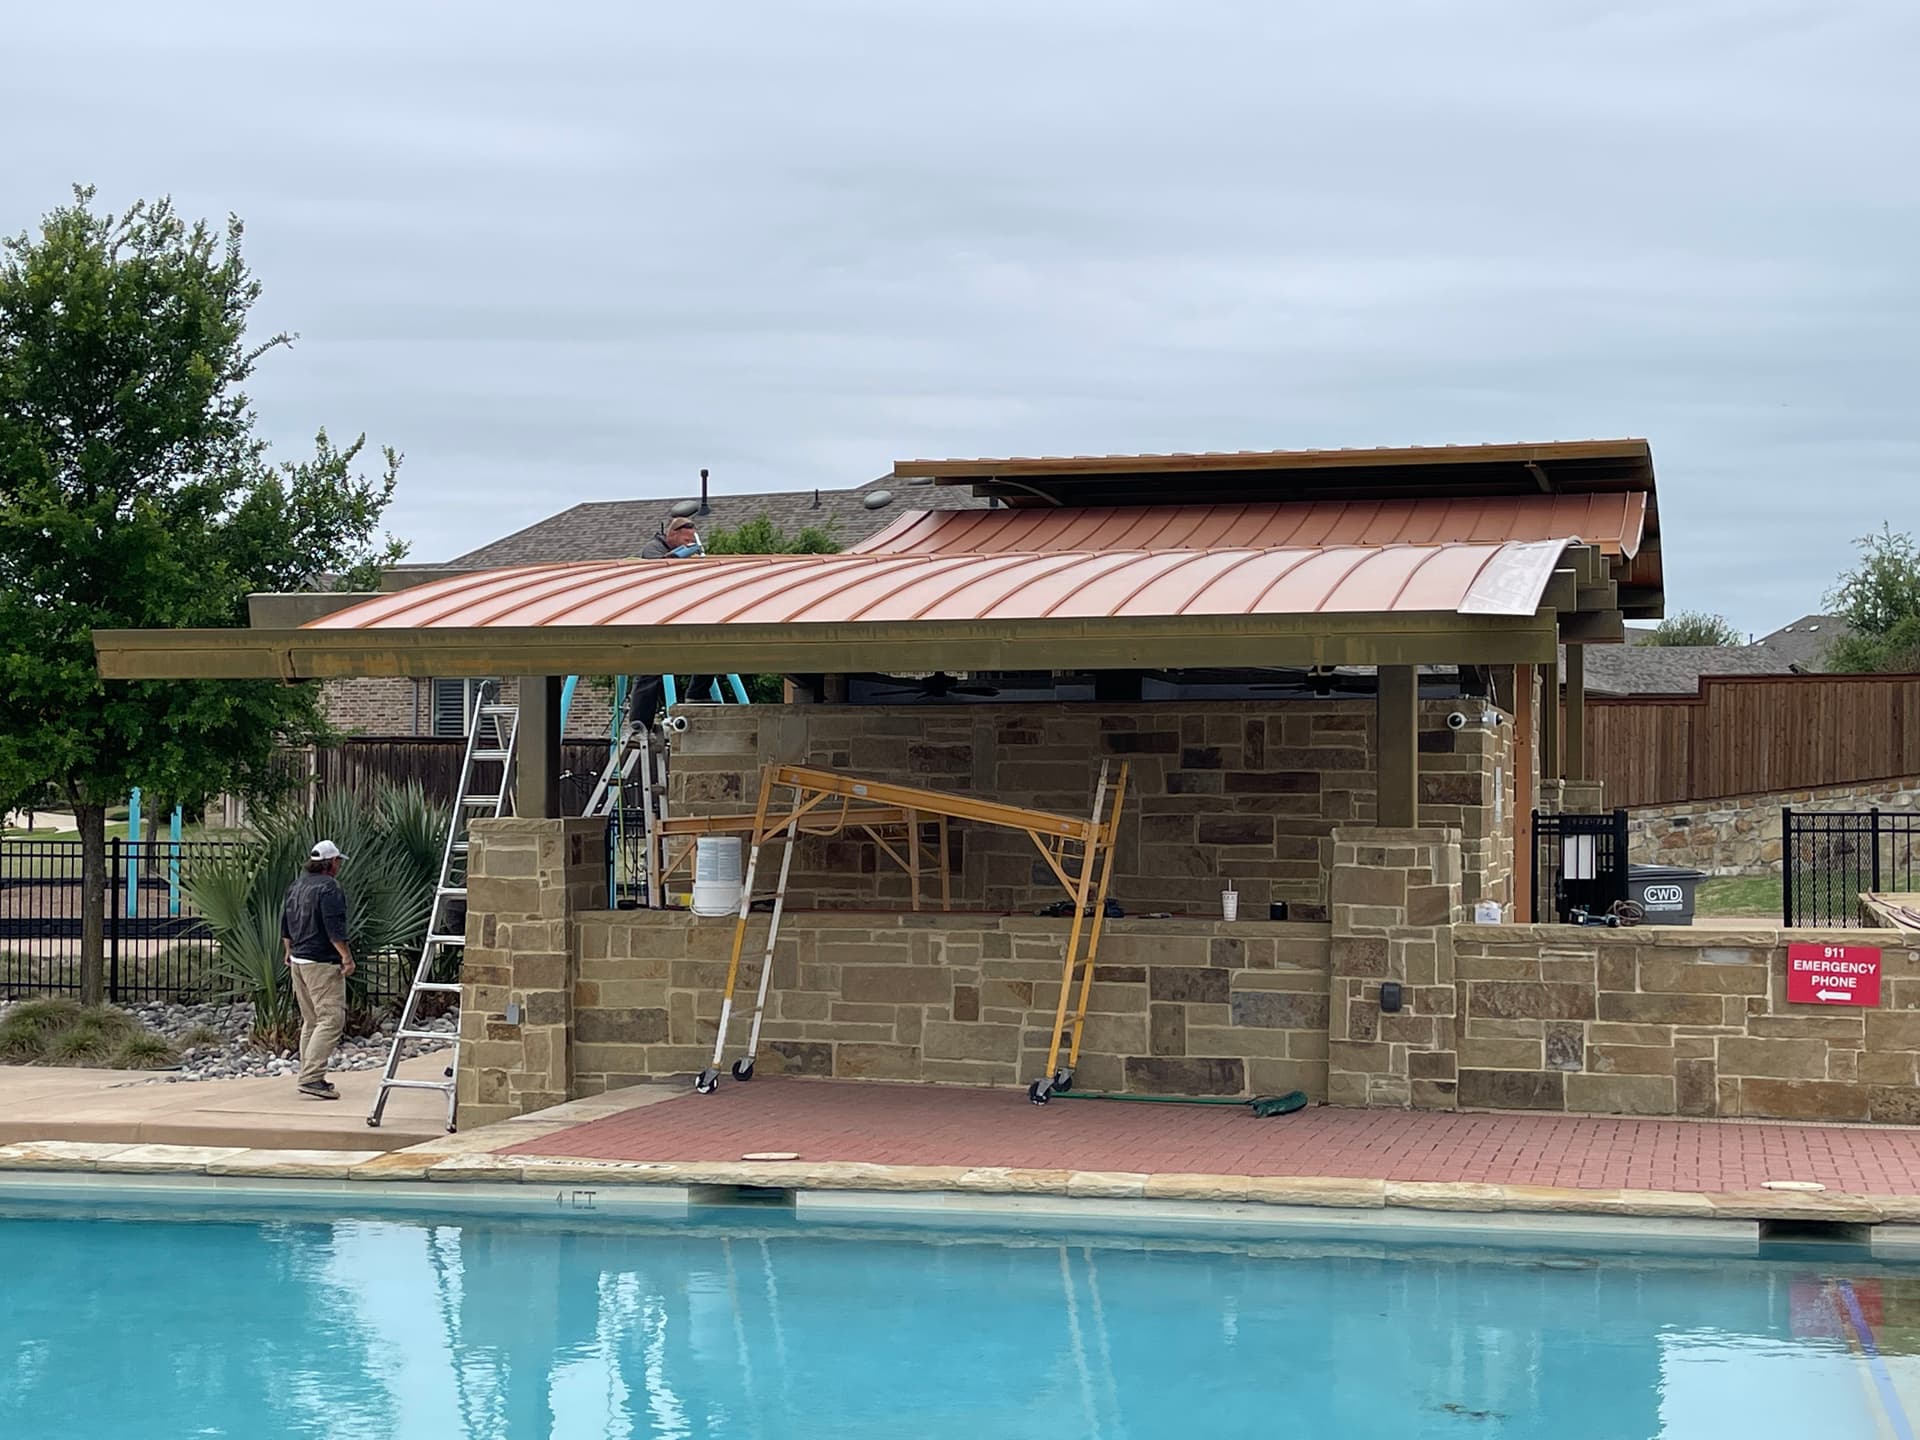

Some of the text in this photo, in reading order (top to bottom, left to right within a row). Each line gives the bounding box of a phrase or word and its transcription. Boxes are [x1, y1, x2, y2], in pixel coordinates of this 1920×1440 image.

[1647, 888, 1679, 900] CWD
[1824, 947, 1845, 958] 911
[1793, 960, 1876, 974] EMERGENCY
[1811, 975, 1857, 988] PHONE
